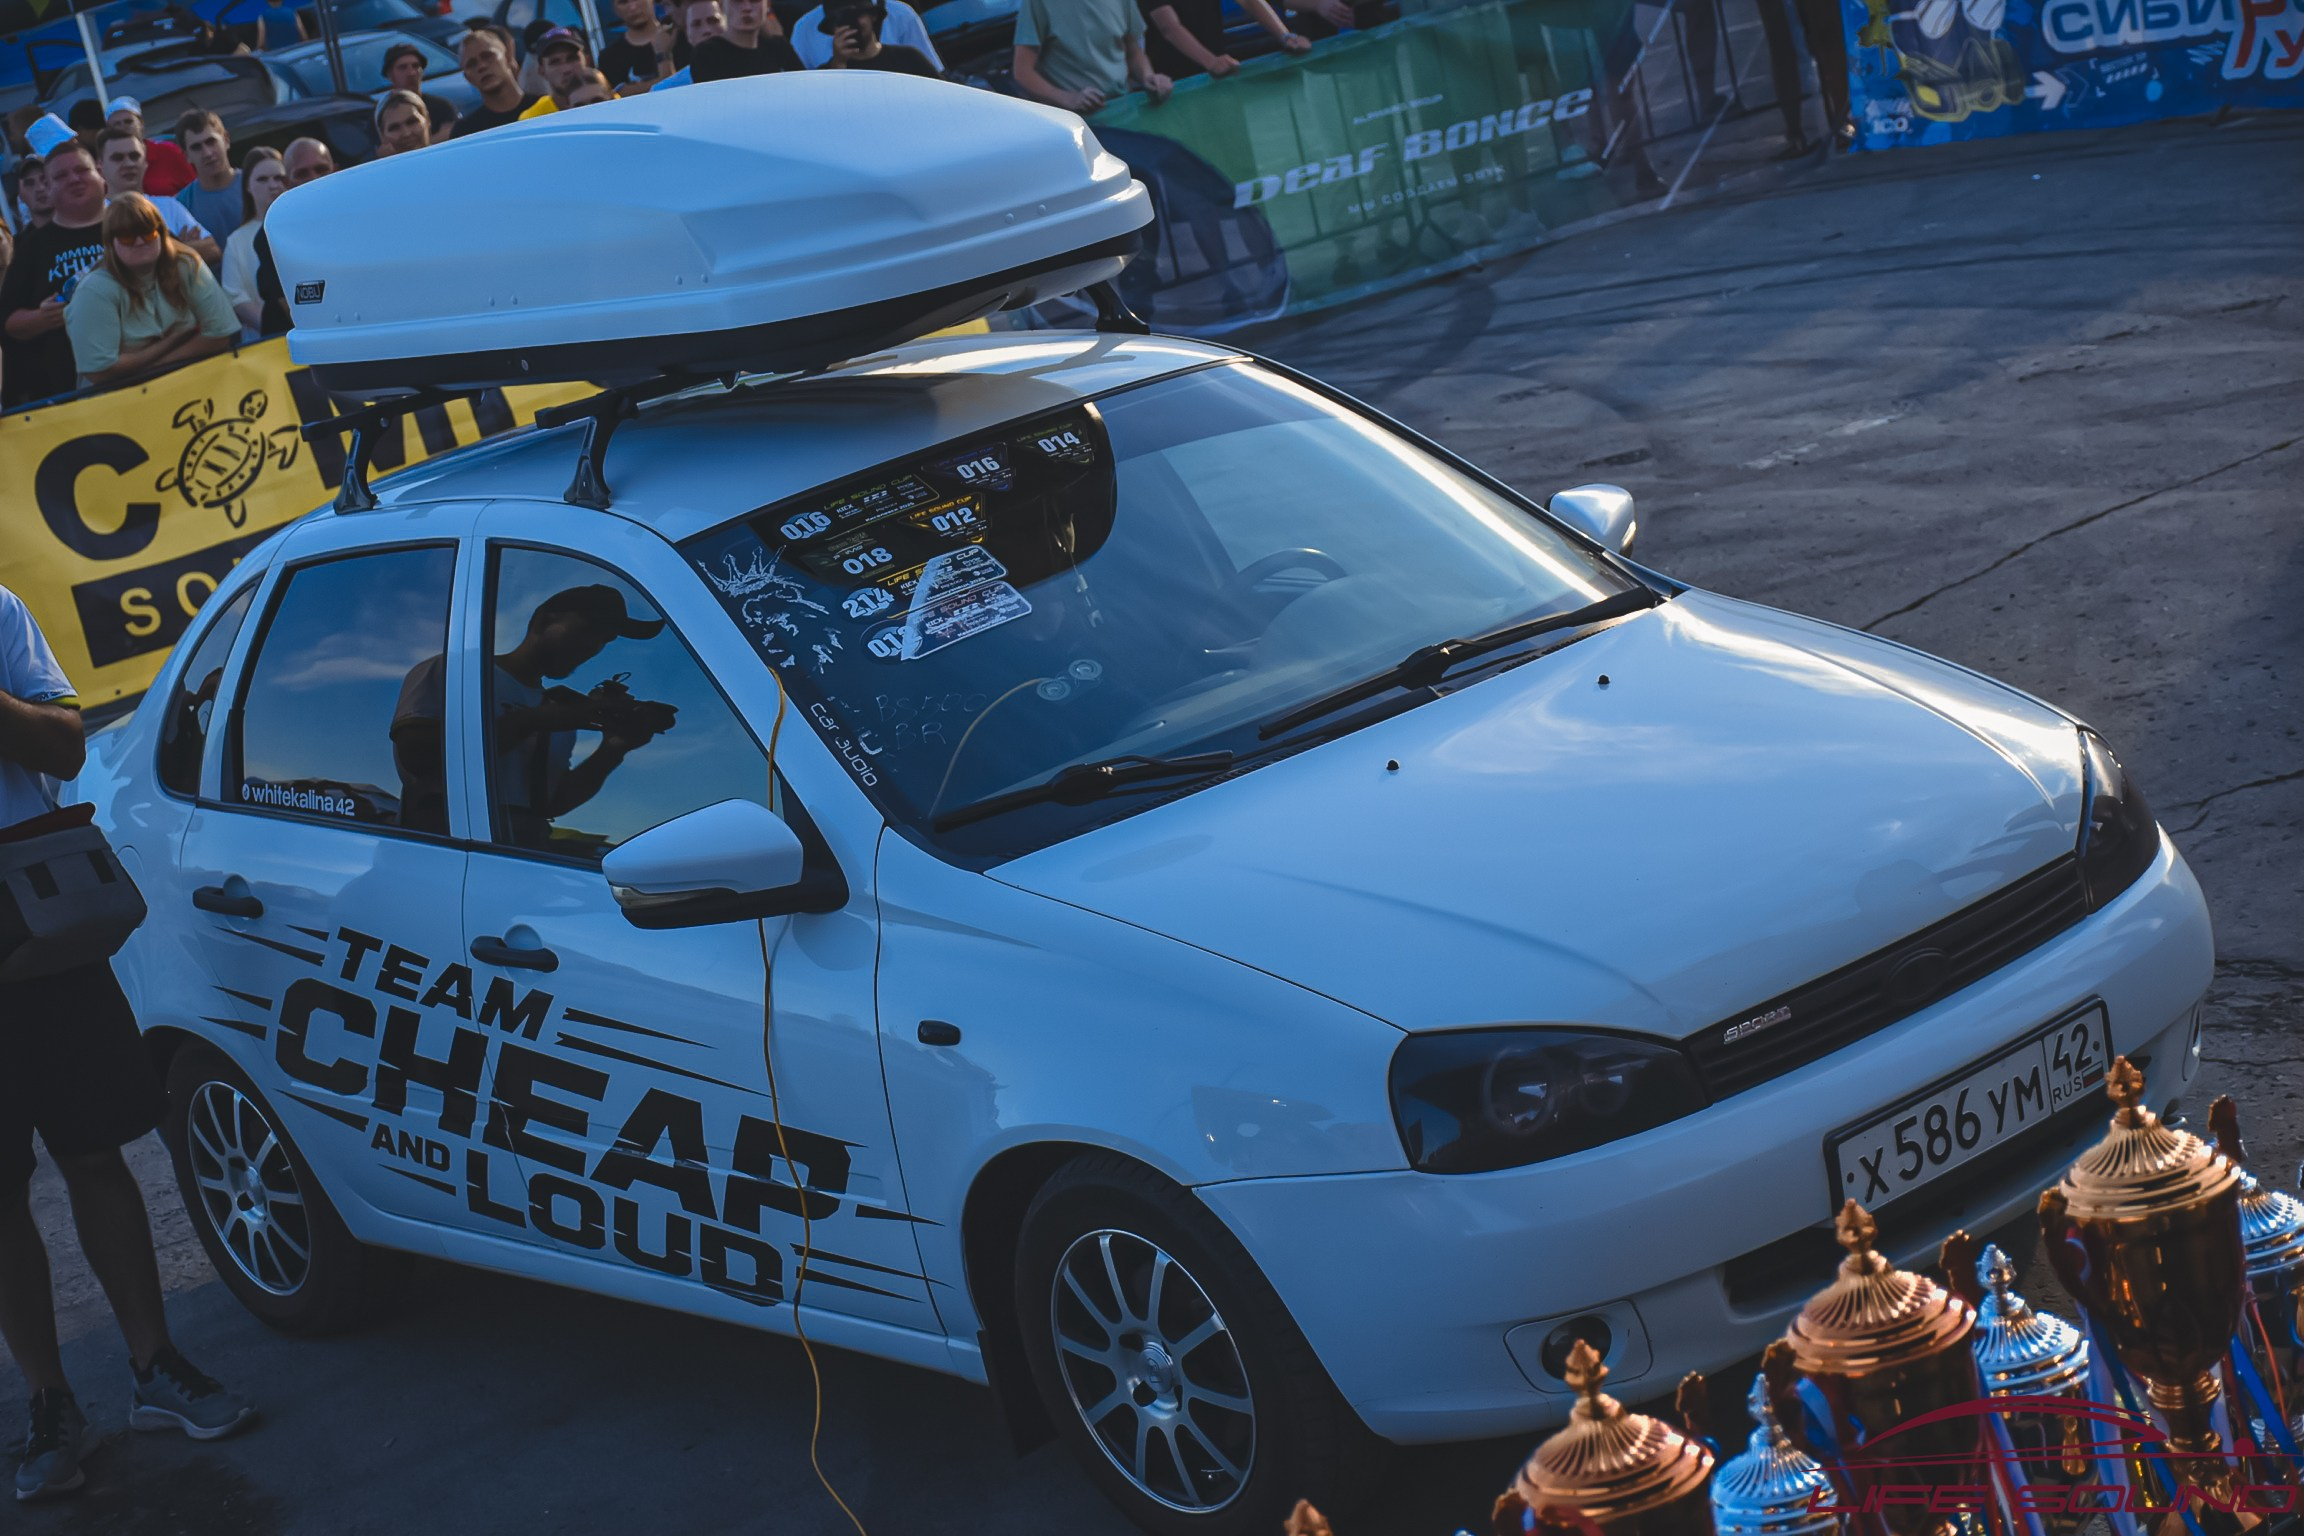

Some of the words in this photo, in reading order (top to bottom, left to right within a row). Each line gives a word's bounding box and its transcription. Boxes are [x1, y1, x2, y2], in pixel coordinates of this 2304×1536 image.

[1037, 431, 1081, 453] 014
[956, 456, 1000, 479] 016
[780, 511, 831, 540] 016
[931, 507, 977, 532] 012
[842, 547, 893, 575] 018
[120, 557, 243, 637] SO
[841, 587, 895, 619] 214
[337, 926, 554, 1041] TEAM
[2052, 1023, 2093, 1079] 42
[275, 978, 866, 1233] CHEAP
[2053, 1075, 2083, 1105] RUS
[370, 1122, 452, 1173] AND
[467, 1148, 785, 1307] LOUD
